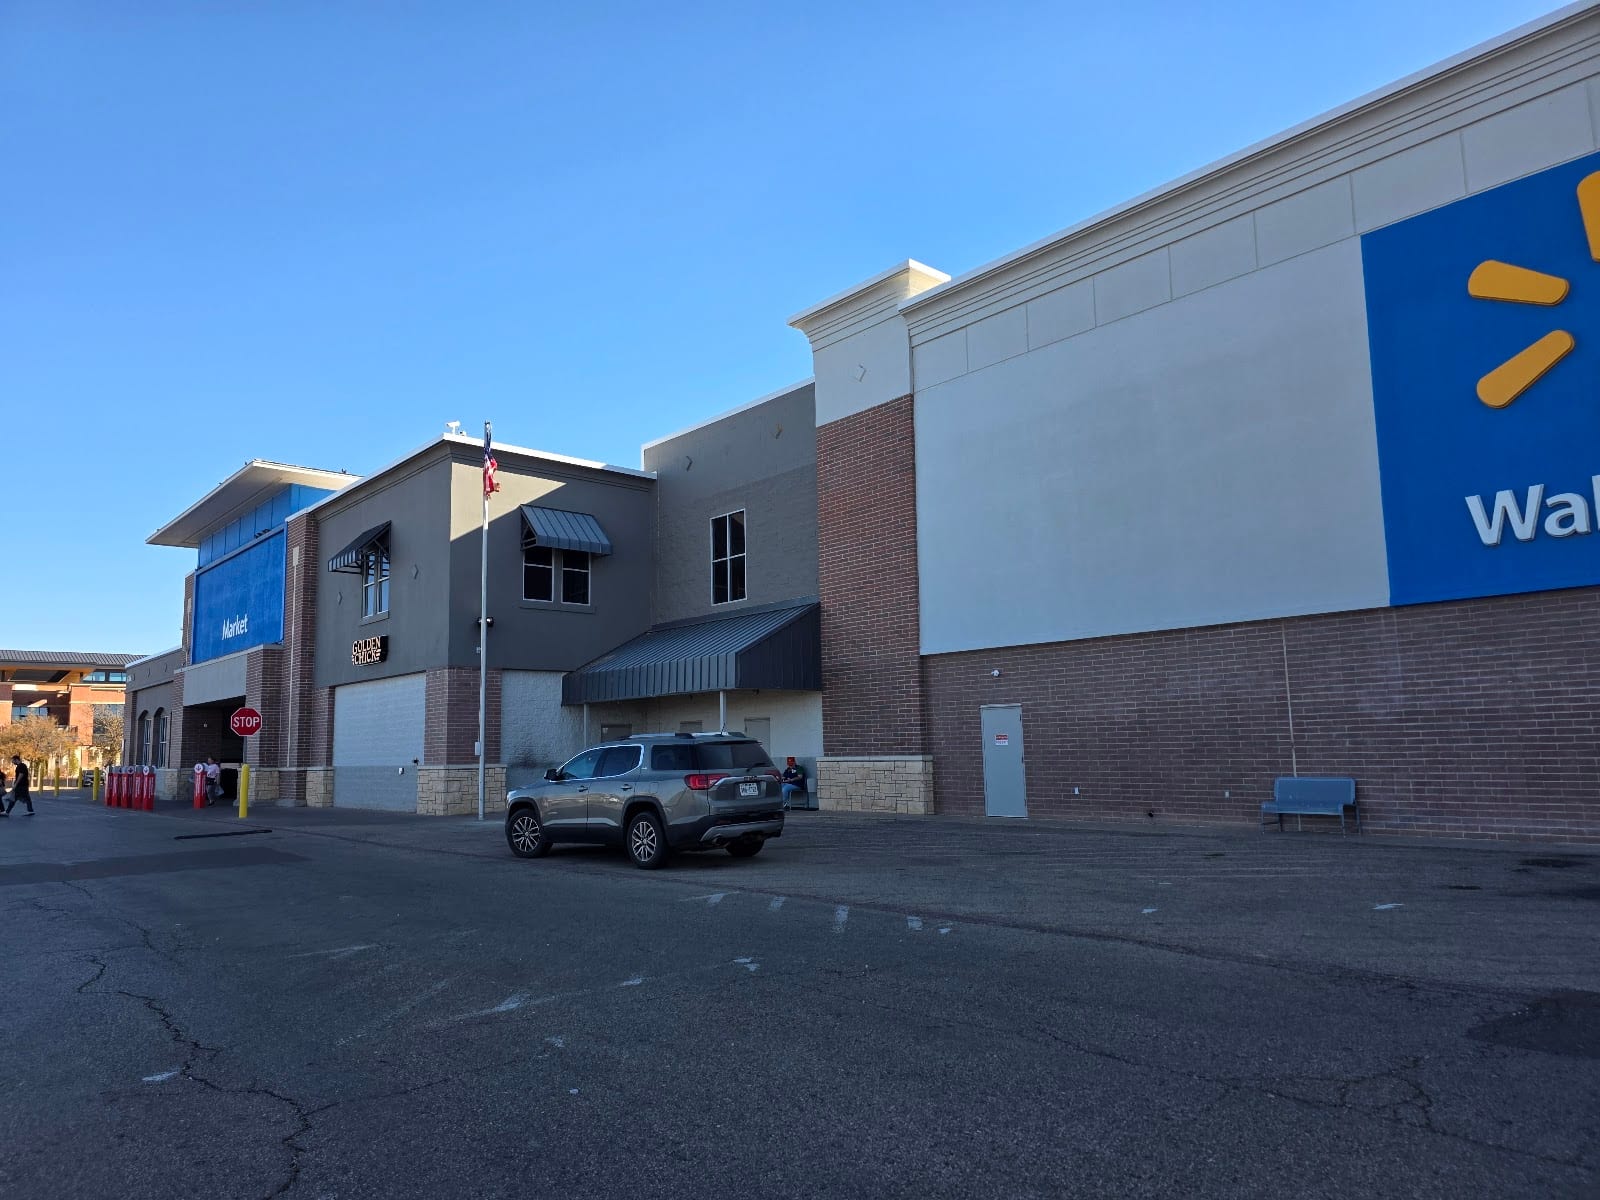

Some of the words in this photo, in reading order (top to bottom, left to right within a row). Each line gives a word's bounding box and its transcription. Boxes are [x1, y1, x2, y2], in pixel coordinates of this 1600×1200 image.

[221, 613, 248, 640] Market
[352, 636, 381, 655] GOLDEN
[354, 649, 378, 665] CHICK
[233, 716, 260, 728] STOP
